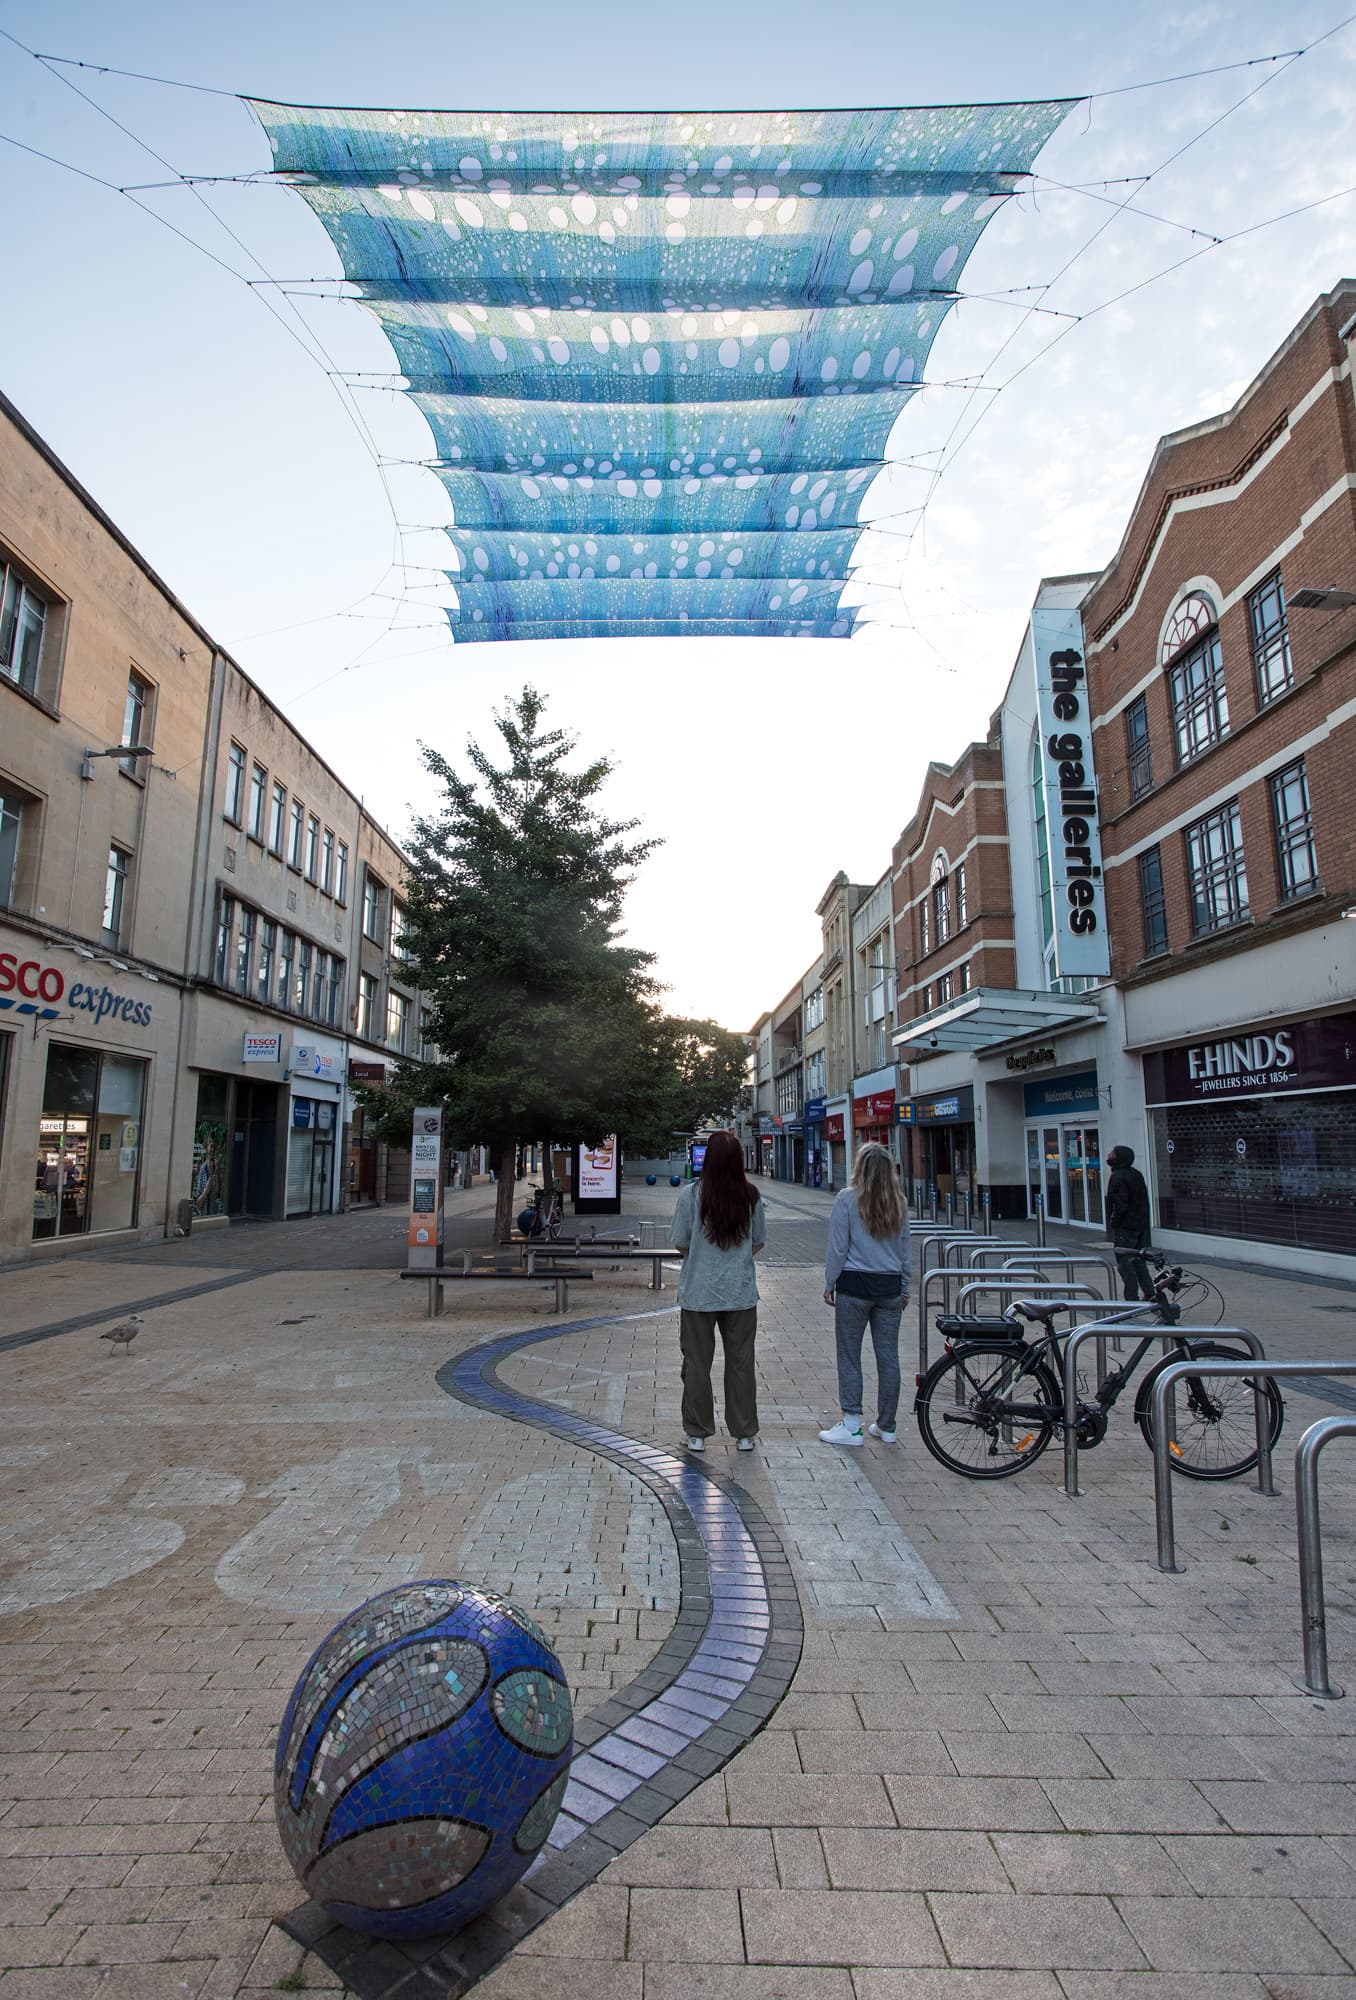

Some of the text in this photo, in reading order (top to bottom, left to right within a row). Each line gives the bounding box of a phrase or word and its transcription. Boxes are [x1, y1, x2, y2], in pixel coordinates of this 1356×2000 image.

[1048, 648, 1102, 935] the galleries
[68, 982, 152, 1027] express
[1202, 1070, 1289, 1093] JEWELLERS SINCE 1856
